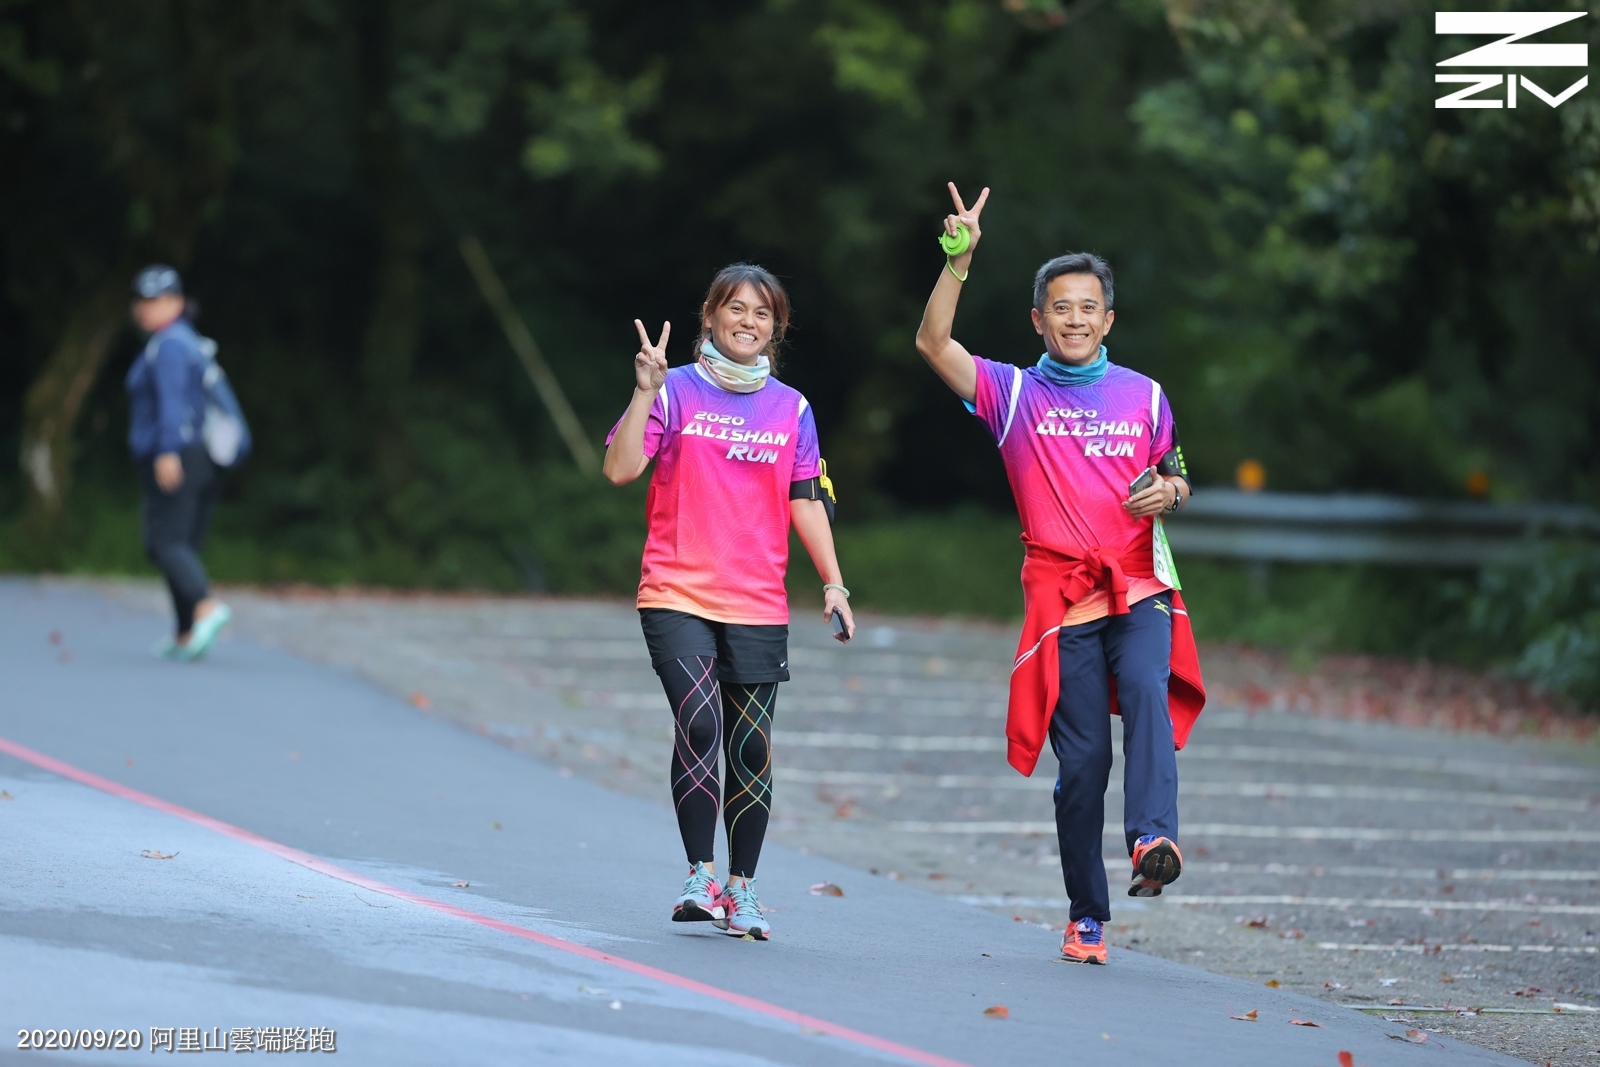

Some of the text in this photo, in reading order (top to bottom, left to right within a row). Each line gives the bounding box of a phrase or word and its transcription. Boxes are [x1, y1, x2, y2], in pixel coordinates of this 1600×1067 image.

[694, 410, 745, 426] 2020
[1046, 407, 1098, 418] 2020
[681, 421, 791, 447] ALISHAN
[1035, 418, 1144, 438] ALISHAN
[725, 443, 779, 465] RUN
[1084, 438, 1136, 457] RUN
